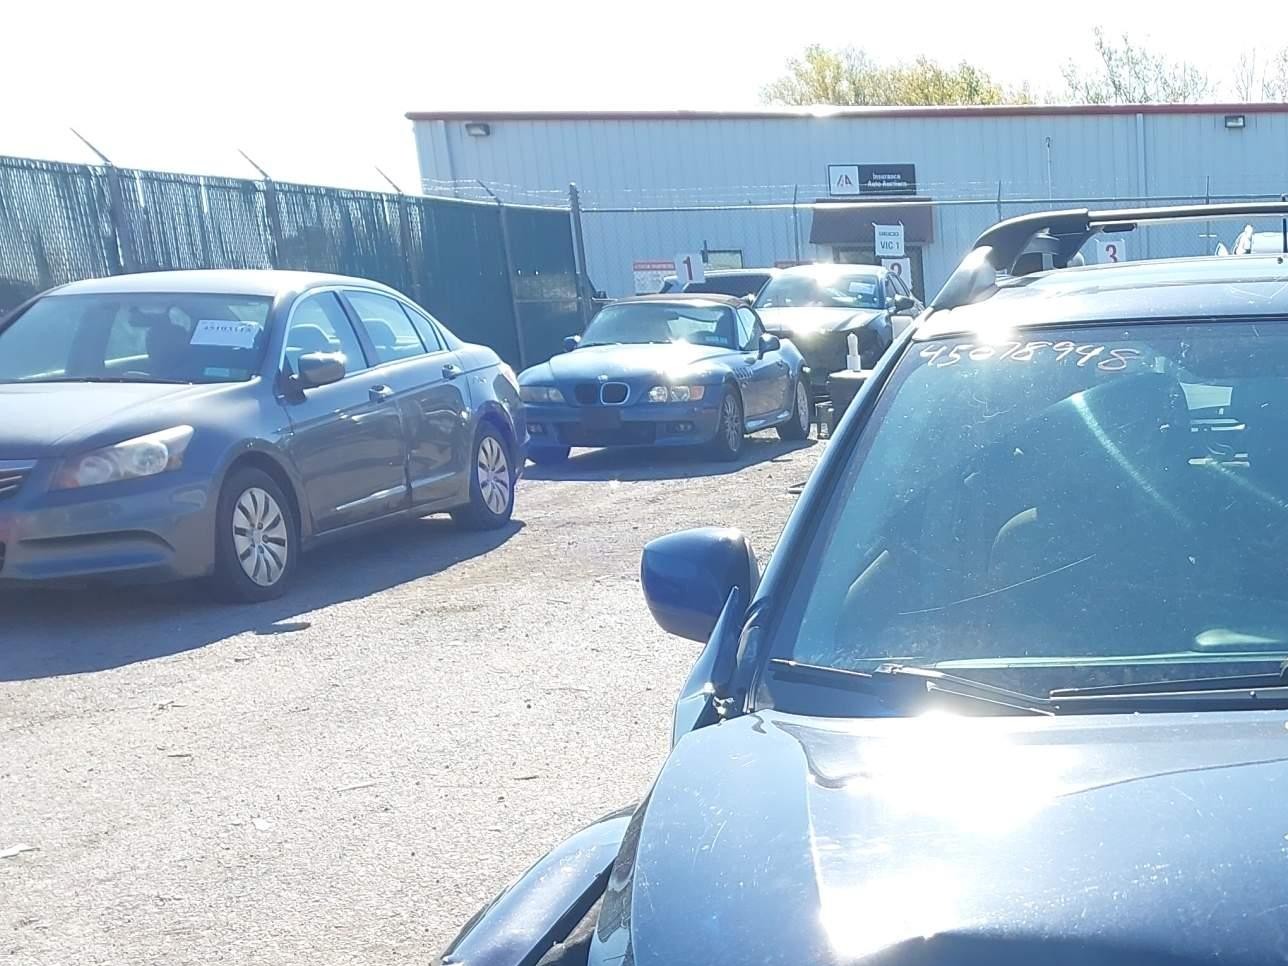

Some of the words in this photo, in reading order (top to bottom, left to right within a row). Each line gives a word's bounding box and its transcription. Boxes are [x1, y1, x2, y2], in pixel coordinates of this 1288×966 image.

[1105, 244, 1118, 263] 3
[682, 255, 694, 281] 1
[919, 340, 1142, 371] 45078948
